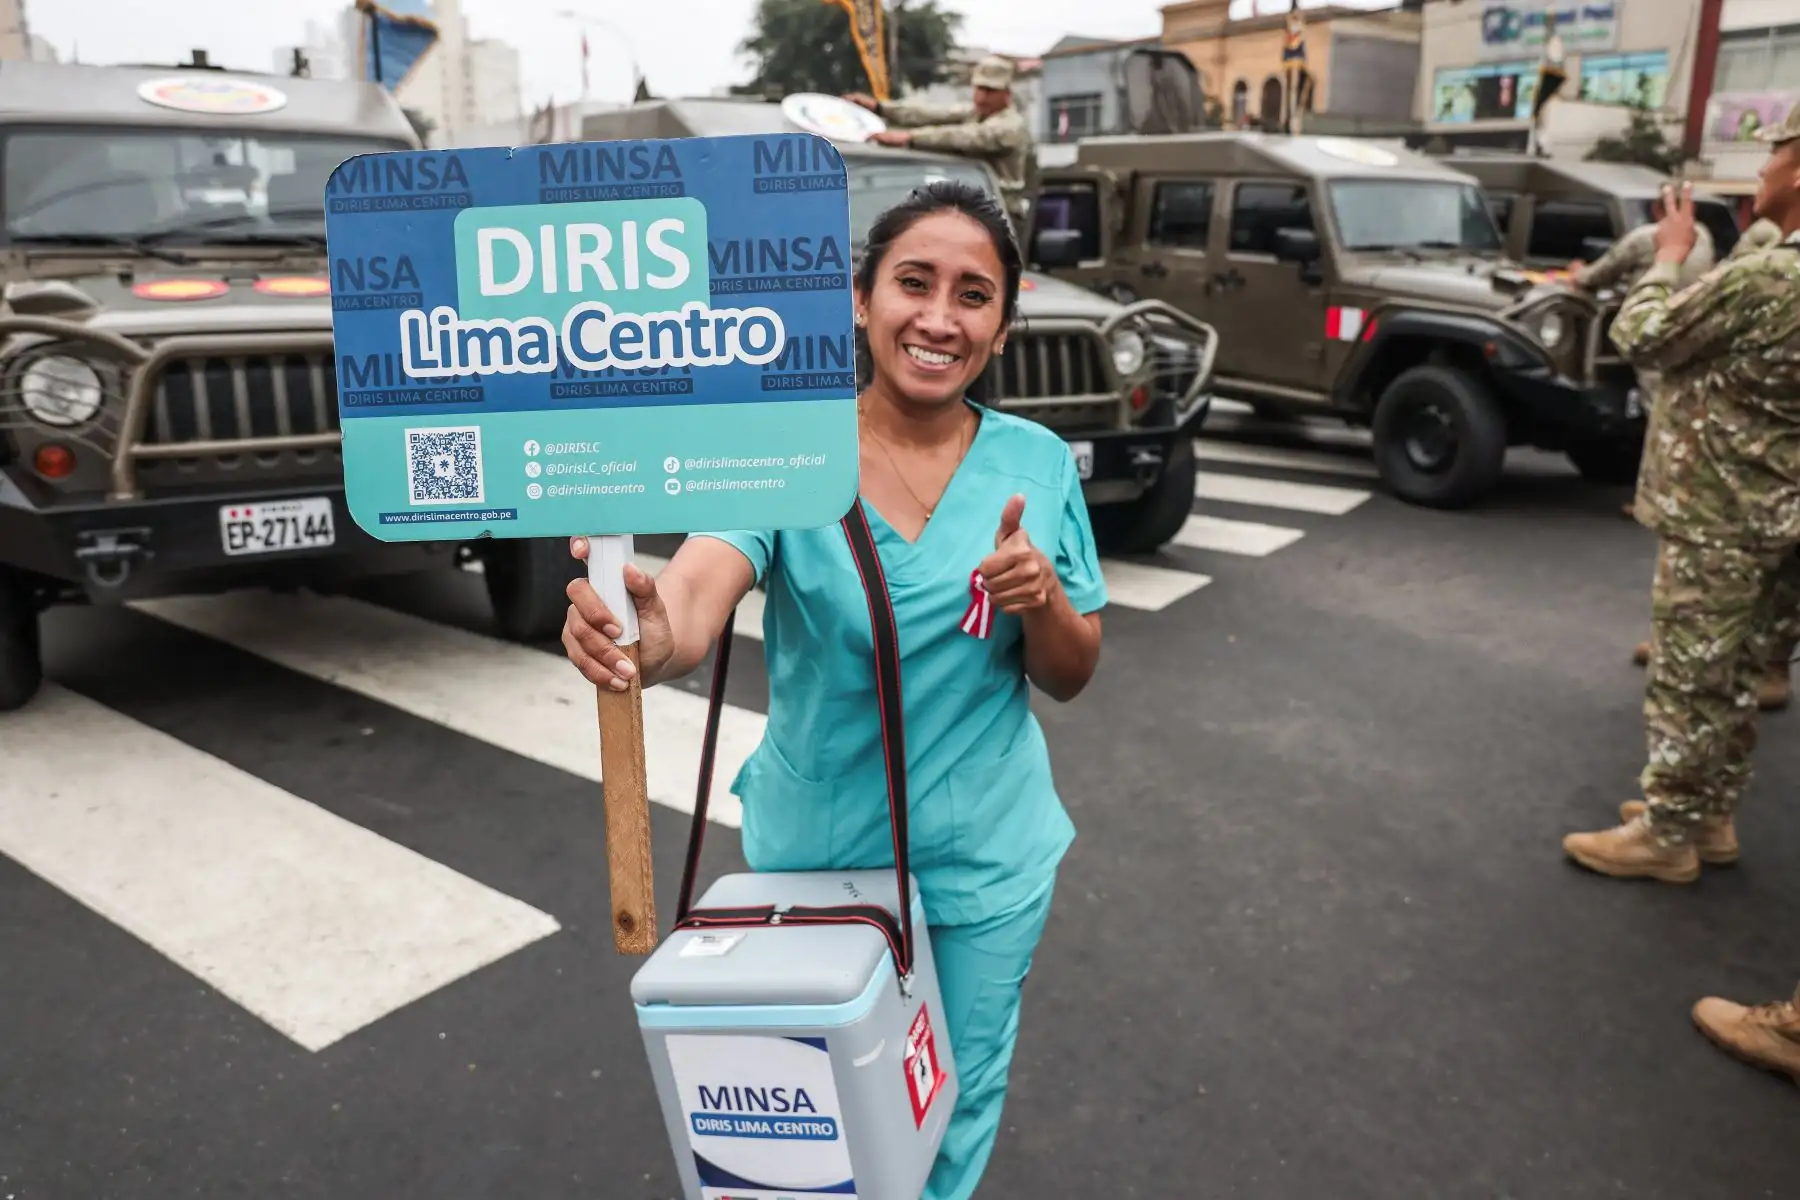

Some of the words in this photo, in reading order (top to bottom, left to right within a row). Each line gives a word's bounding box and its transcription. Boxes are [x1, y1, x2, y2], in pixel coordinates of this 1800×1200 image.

[539, 144, 682, 184] MINSA
[329, 155, 469, 194] MINSA
[545, 188, 581, 201] DIRIS
[585, 186, 619, 199] LIMA
[623, 184, 680, 197] CENTRO
[759, 179, 796, 191] DIRIS
[800, 177, 835, 189] LIMA
[334, 200, 372, 211] DIRIS
[375, 198, 409, 210] LIMA
[412, 195, 468, 208] CENTRO
[477, 218, 691, 297] DIRIS
[708, 235, 845, 275] MINSA
[336, 253, 420, 291] NSA
[708, 280, 744, 293] DIRIS
[748, 278, 782, 291] LIMA
[786, 275, 843, 289] CENTRO
[364, 295, 419, 308] CENTRO
[405, 311, 553, 372] Lima
[566, 305, 782, 366] Centro
[762, 334, 854, 371] MIN
[556, 384, 592, 397] DIRIS
[595, 383, 628, 395] LIMA
[633, 380, 688, 393] CENTRO
[767, 376, 804, 388] DIRIS
[808, 375, 842, 387] LIMA
[349, 392, 384, 405] DIRIS
[388, 391, 421, 403] LIMA
[425, 389, 479, 402] CENTRO
[544, 442, 601, 456] @DIRISLC
[545, 460, 638, 476] @DirisLC_oficial
[684, 454, 827, 471] @dirislimacentro_oficial
[547, 483, 645, 497] @dirislimacentro
[685, 477, 786, 492] @dirislimacentro
[385, 510, 512, 523] www.dirislimacentro.gob.pe
[698, 1085, 818, 1113] MINSA
[695, 1117, 732, 1132] DIRIS
[734, 1120, 772, 1134] LIMA
[774, 1121, 834, 1136] CENTRO
